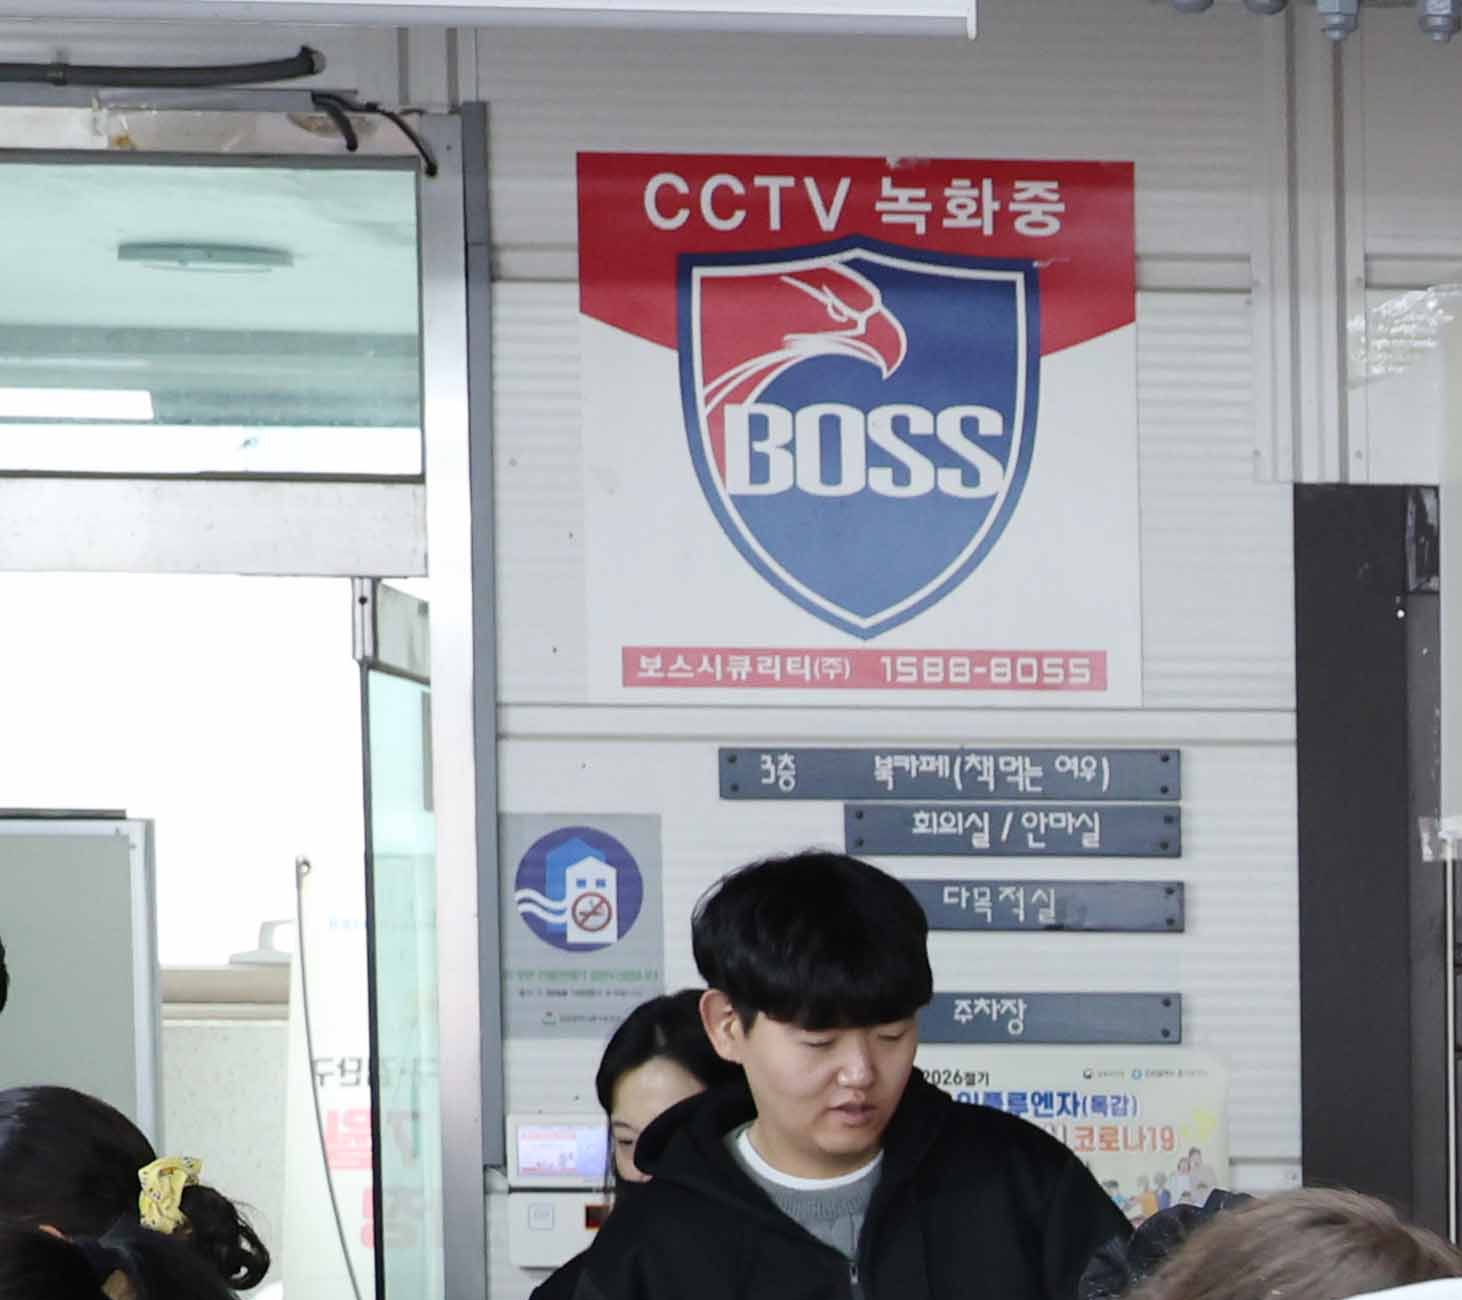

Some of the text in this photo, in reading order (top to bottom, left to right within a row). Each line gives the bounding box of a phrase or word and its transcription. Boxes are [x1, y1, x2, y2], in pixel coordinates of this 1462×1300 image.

[644, 173, 1066, 237] CCTV 녹화중
[724, 404, 1006, 499] BOSS
[637, 654, 1093, 686] 보스시큐리티(주) 1588-8055
[760, 752, 797, 793] 3층
[912, 811, 990, 849] 회의실
[1021, 811, 1100, 849] 안마실
[943, 886, 1056, 924] 다목적실
[954, 998, 1027, 1036] 주차장
[1073, 1125, 1175, 1152] 코로나19
